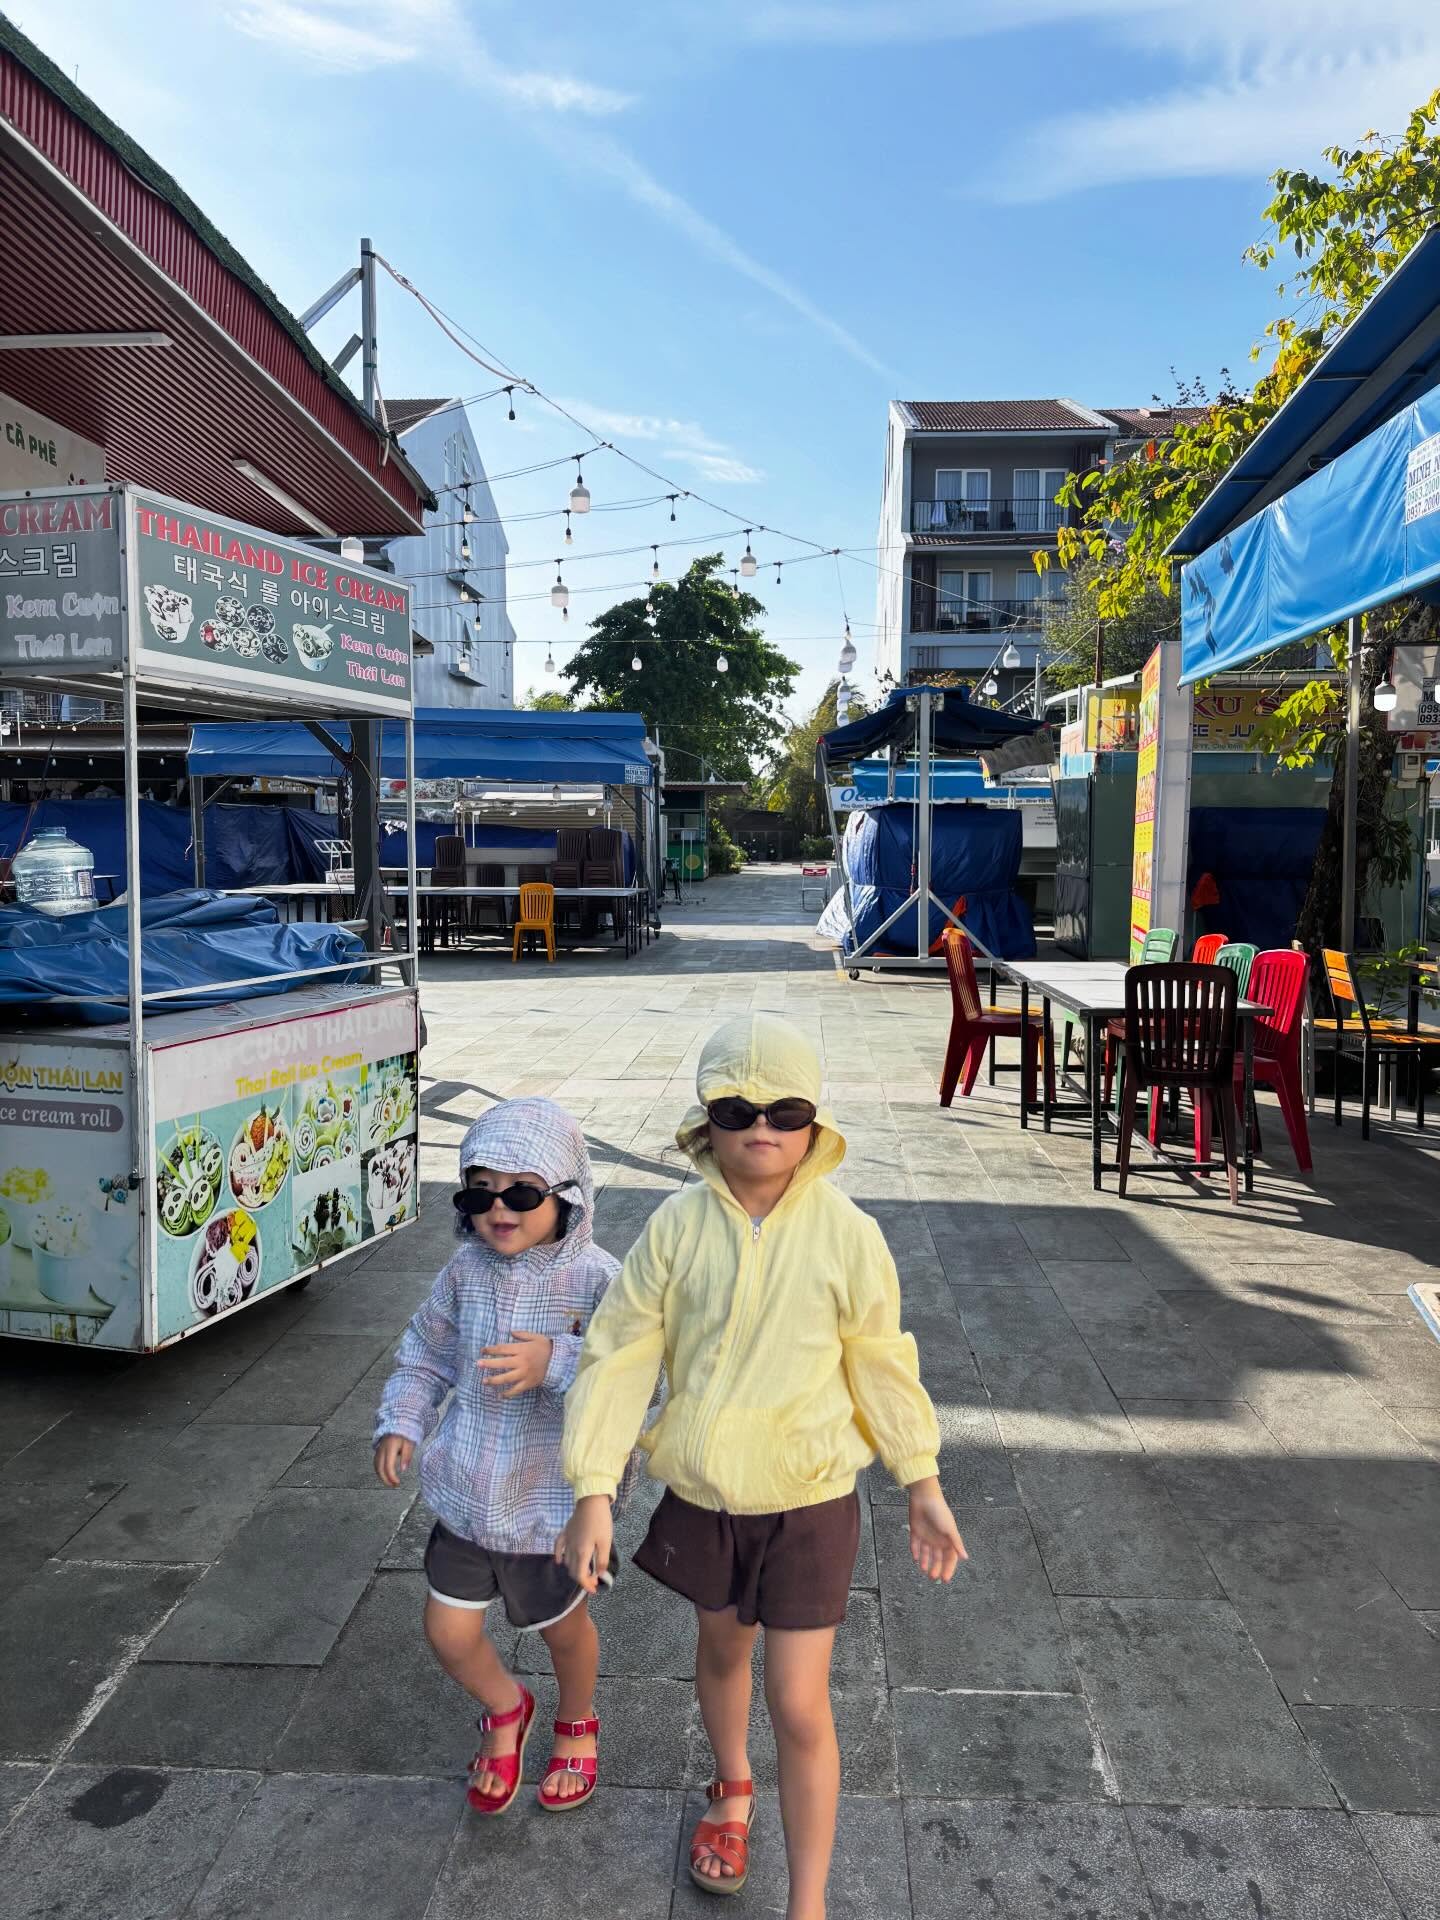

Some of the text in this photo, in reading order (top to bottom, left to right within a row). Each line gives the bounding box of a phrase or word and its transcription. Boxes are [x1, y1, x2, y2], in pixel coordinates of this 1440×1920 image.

[28, 434, 58, 468] PHÊ
[1, 497, 113, 537] CREAM
[136, 507, 406, 615] THAILAND ICE CREAM
[7, 594, 60, 622] Kem
[173, 554, 385, 635] 태국식 롤 아이스크림
[71, 632, 112, 656] Lan
[340, 633, 373, 658] Kem
[380, 668, 406, 688] Lan
[37, 1064, 80, 1087] THÁI
[84, 1071, 123, 1089] LAN
[235, 1074, 267, 1098] Thai
[271, 1066, 297, 1089] Roll
[321, 1052, 362, 1074] Cream
[22, 1108, 76, 1125] cream
[79, 1109, 112, 1128] roll
